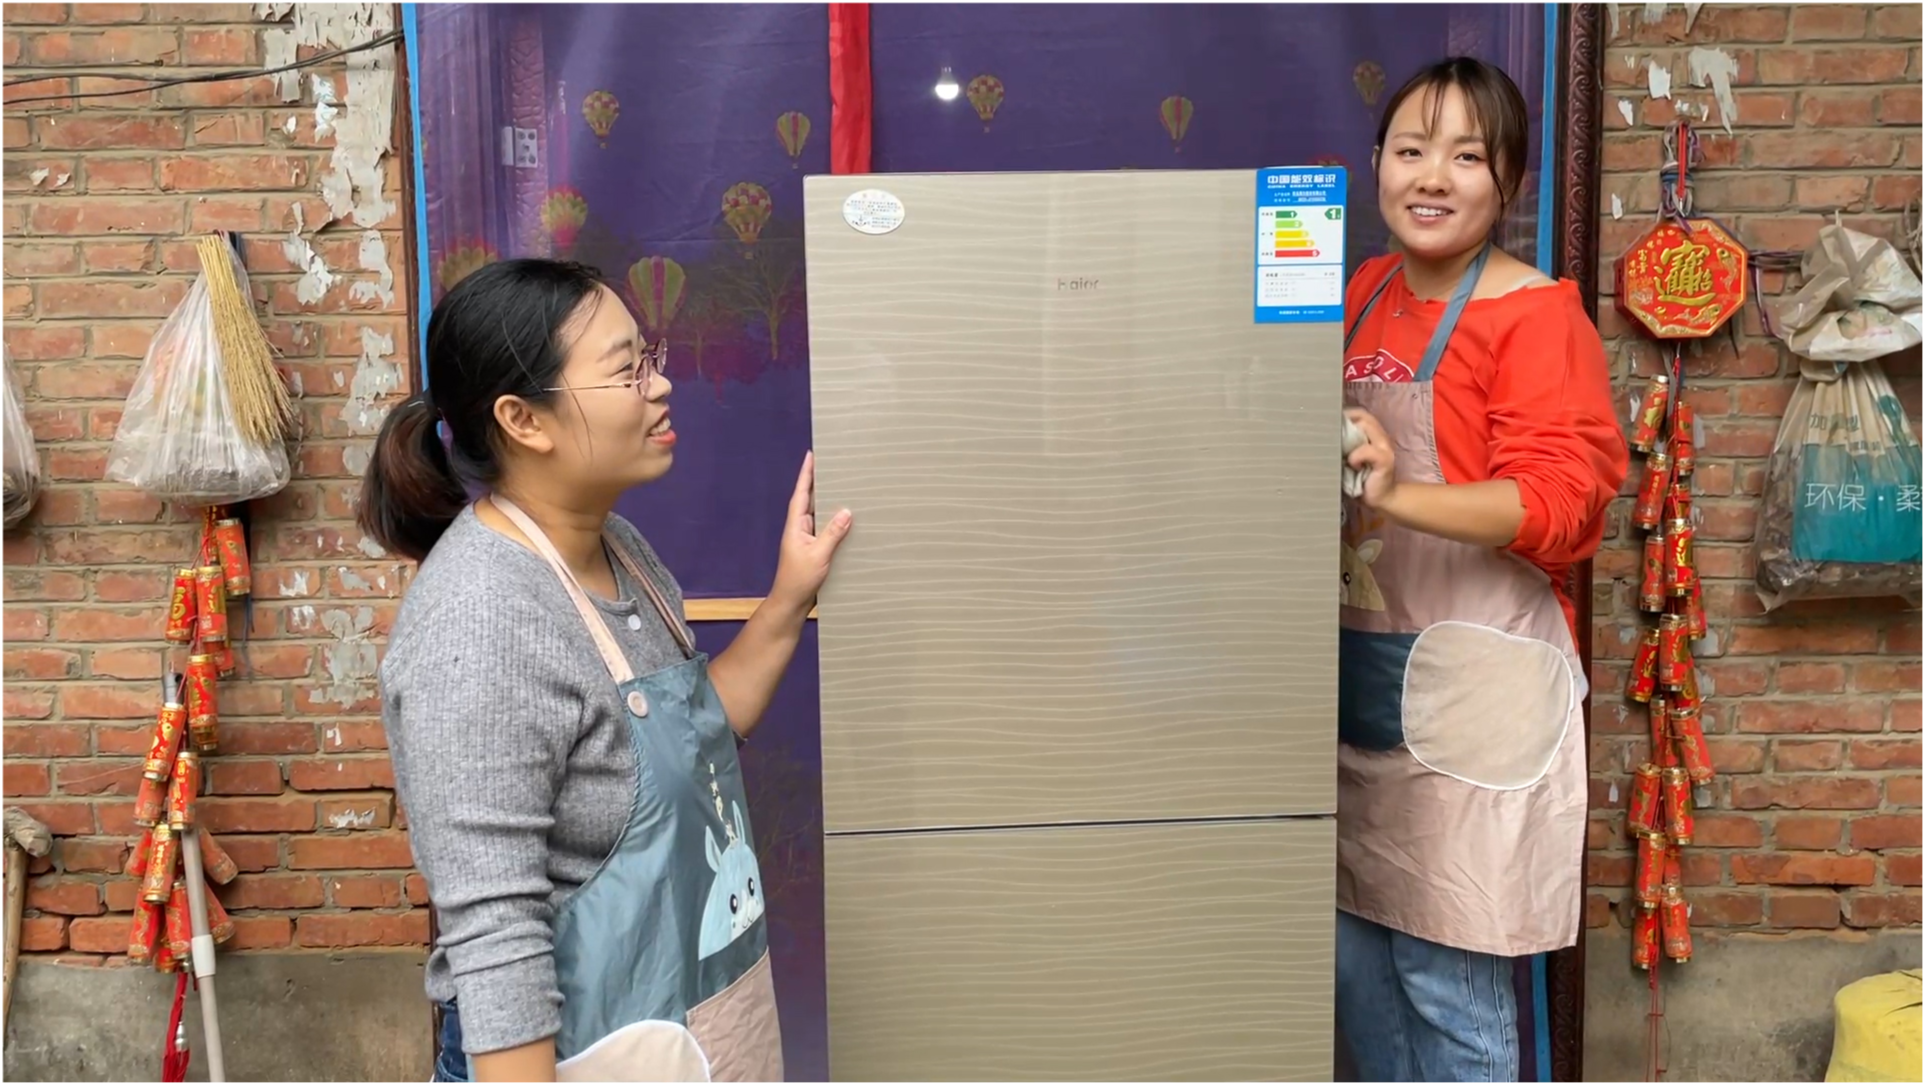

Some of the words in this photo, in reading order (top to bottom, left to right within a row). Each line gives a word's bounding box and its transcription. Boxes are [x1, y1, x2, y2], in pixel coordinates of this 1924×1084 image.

[1267, 174, 1337, 184] 中国能效标识
